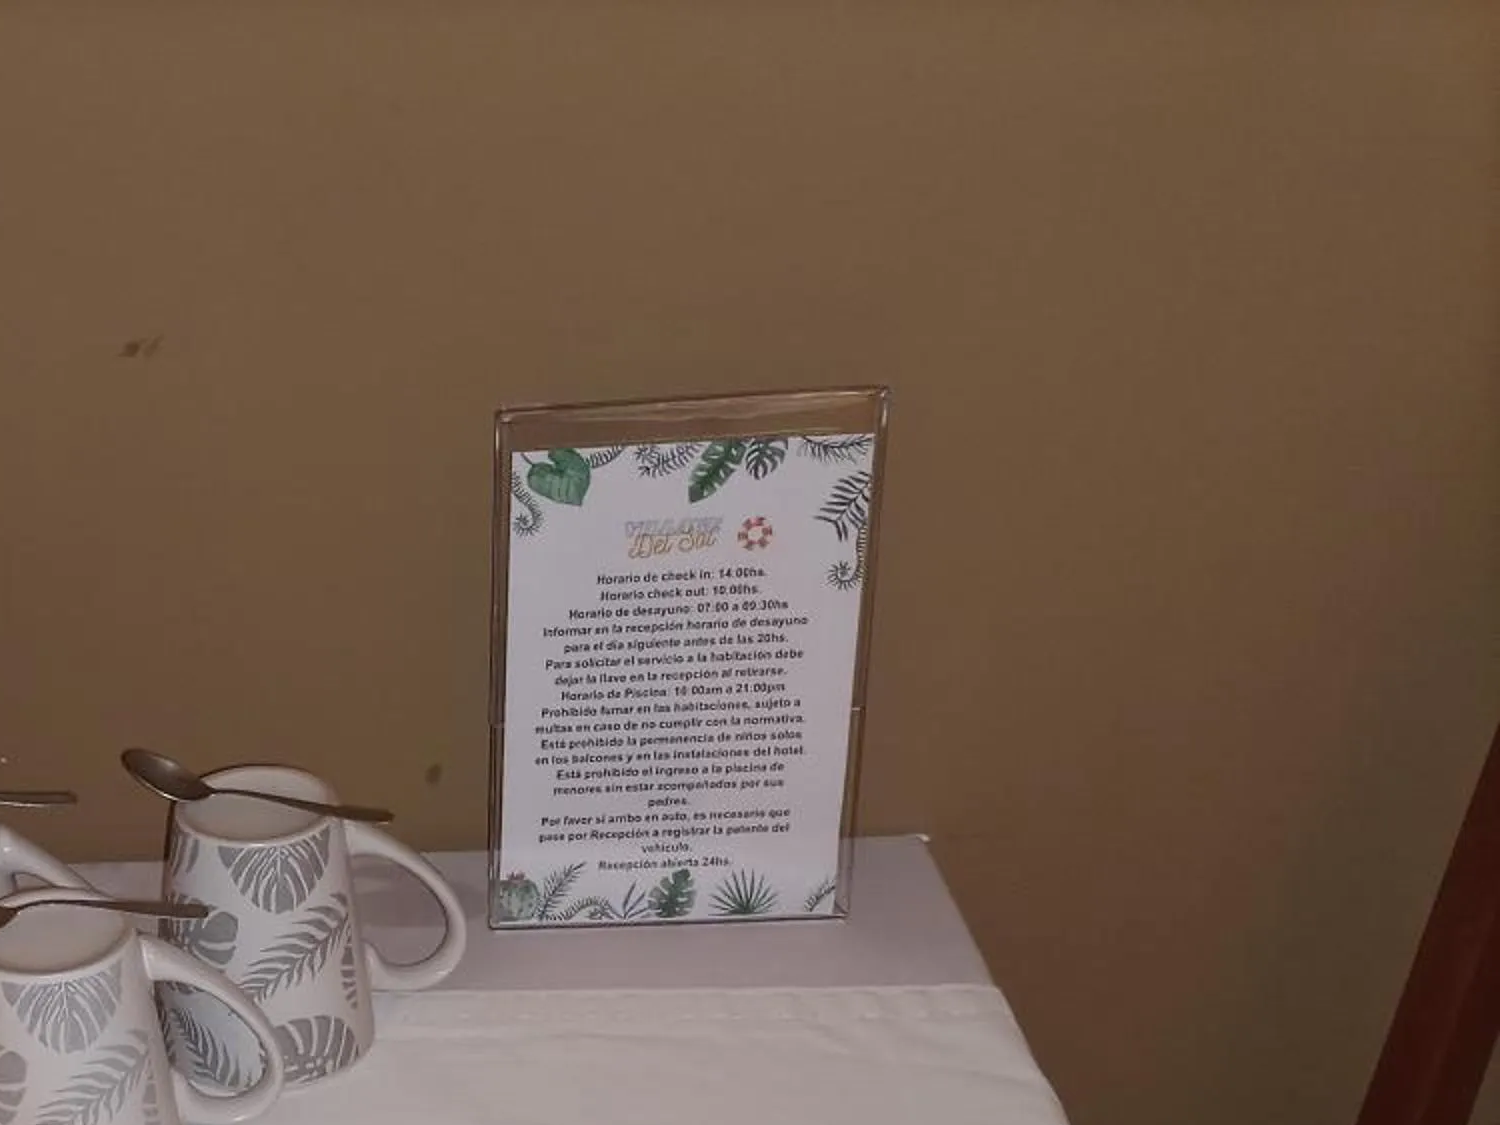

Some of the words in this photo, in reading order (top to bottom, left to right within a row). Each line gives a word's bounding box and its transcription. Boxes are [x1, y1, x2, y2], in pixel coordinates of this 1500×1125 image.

[597, 573, 641, 585] Horario
[644, 572, 659, 582] de
[661, 570, 696, 582] check
[600, 589, 644, 601] Horario
[648, 587, 682, 599] check
[569, 607, 612, 619] Horario
[615, 607, 630, 617] de
[731, 603, 740, 611] a
[595, 626, 609, 635] en
[611, 623, 623, 634] la
[625, 621, 683, 634] recepción
[686, 619, 729, 630] horario
[731, 618, 746, 628] de
[749, 617, 809, 628] desayuno
[563, 644, 590, 655] para
[592, 641, 604, 651] el
[628, 637, 680, 651] siguiente
[683, 636, 716, 647] antes
[719, 635, 734, 645] de
[737, 634, 755, 644] las
[545, 659, 572, 670] Para
[574, 657, 622, 668] solicitar
[624, 655, 635, 666] el
[637, 653, 683, 666] servicio
[686, 655, 694, 663] a
[697, 652, 708, 663] la
[711, 649, 771, 662] habitación
[774, 648, 804, 659] debe
[555, 675, 583, 688] dejar
[585, 674, 598, 684] la
[599, 673, 627, 684] llave
[629, 674, 644, 682] en
[647, 671, 659, 682] la
[661, 668, 718, 682] recepción
[721, 667, 733, 678] al
[561, 689, 604, 701] Horario
[607, 689, 621, 699] de
[726, 686, 733, 694] a
[541, 706, 598, 718] Prohibido
[600, 705, 634, 716] fumar
[636, 706, 651, 714] en
[653, 703, 671, 713] las
[755, 697, 791, 711] sujeto
[793, 699, 801, 707] a
[535, 723, 573, 734] multas
[575, 724, 591, 732] en
[593, 723, 621, 732] caso
[623, 720, 638, 730] de
[641, 721, 657, 730] no
[659, 717, 703, 730] cumplir
[705, 718, 727, 727] con
[731, 715, 741, 726] la
[568, 736, 624, 751] prohibido
[627, 735, 637, 746] la
[639, 732, 714, 748] permanencia
[717, 732, 732, 742] de
[770, 729, 802, 740] solos
[535, 757, 549, 765] en
[551, 754, 569, 765] los
[571, 753, 623, 764] balcones
[624, 754, 633, 764] y
[636, 753, 651, 761] en
[653, 750, 671, 761] las
[673, 747, 750, 760] instalaciones
[753, 746, 771, 757] del
[583, 766, 639, 781] prohibido
[642, 766, 653, 776] el
[655, 765, 699, 778] ingreso
[701, 766, 709, 774] a
[711, 763, 723, 774] la
[725, 762, 767, 776] piscina
[770, 761, 785, 771] de
[553, 786, 602, 795] menores
[604, 783, 622, 793] sin
[625, 782, 654, 793] estar
[740, 780, 760, 791] por
[763, 779, 785, 787] sus
[541, 816, 561, 826] Por
[563, 815, 592, 825] favor
[644, 814, 659, 822] en
[693, 812, 706, 821] es
[709, 808, 766, 820] necesario
[768, 809, 790, 820] que
[568, 833, 587, 844] por
[590, 828, 650, 842] Recepción
[652, 830, 659, 838] a
[662, 826, 710, 839] registrar
[713, 825, 723, 835] la
[772, 821, 790, 832] del
[598, 858, 658, 872] Recepción
